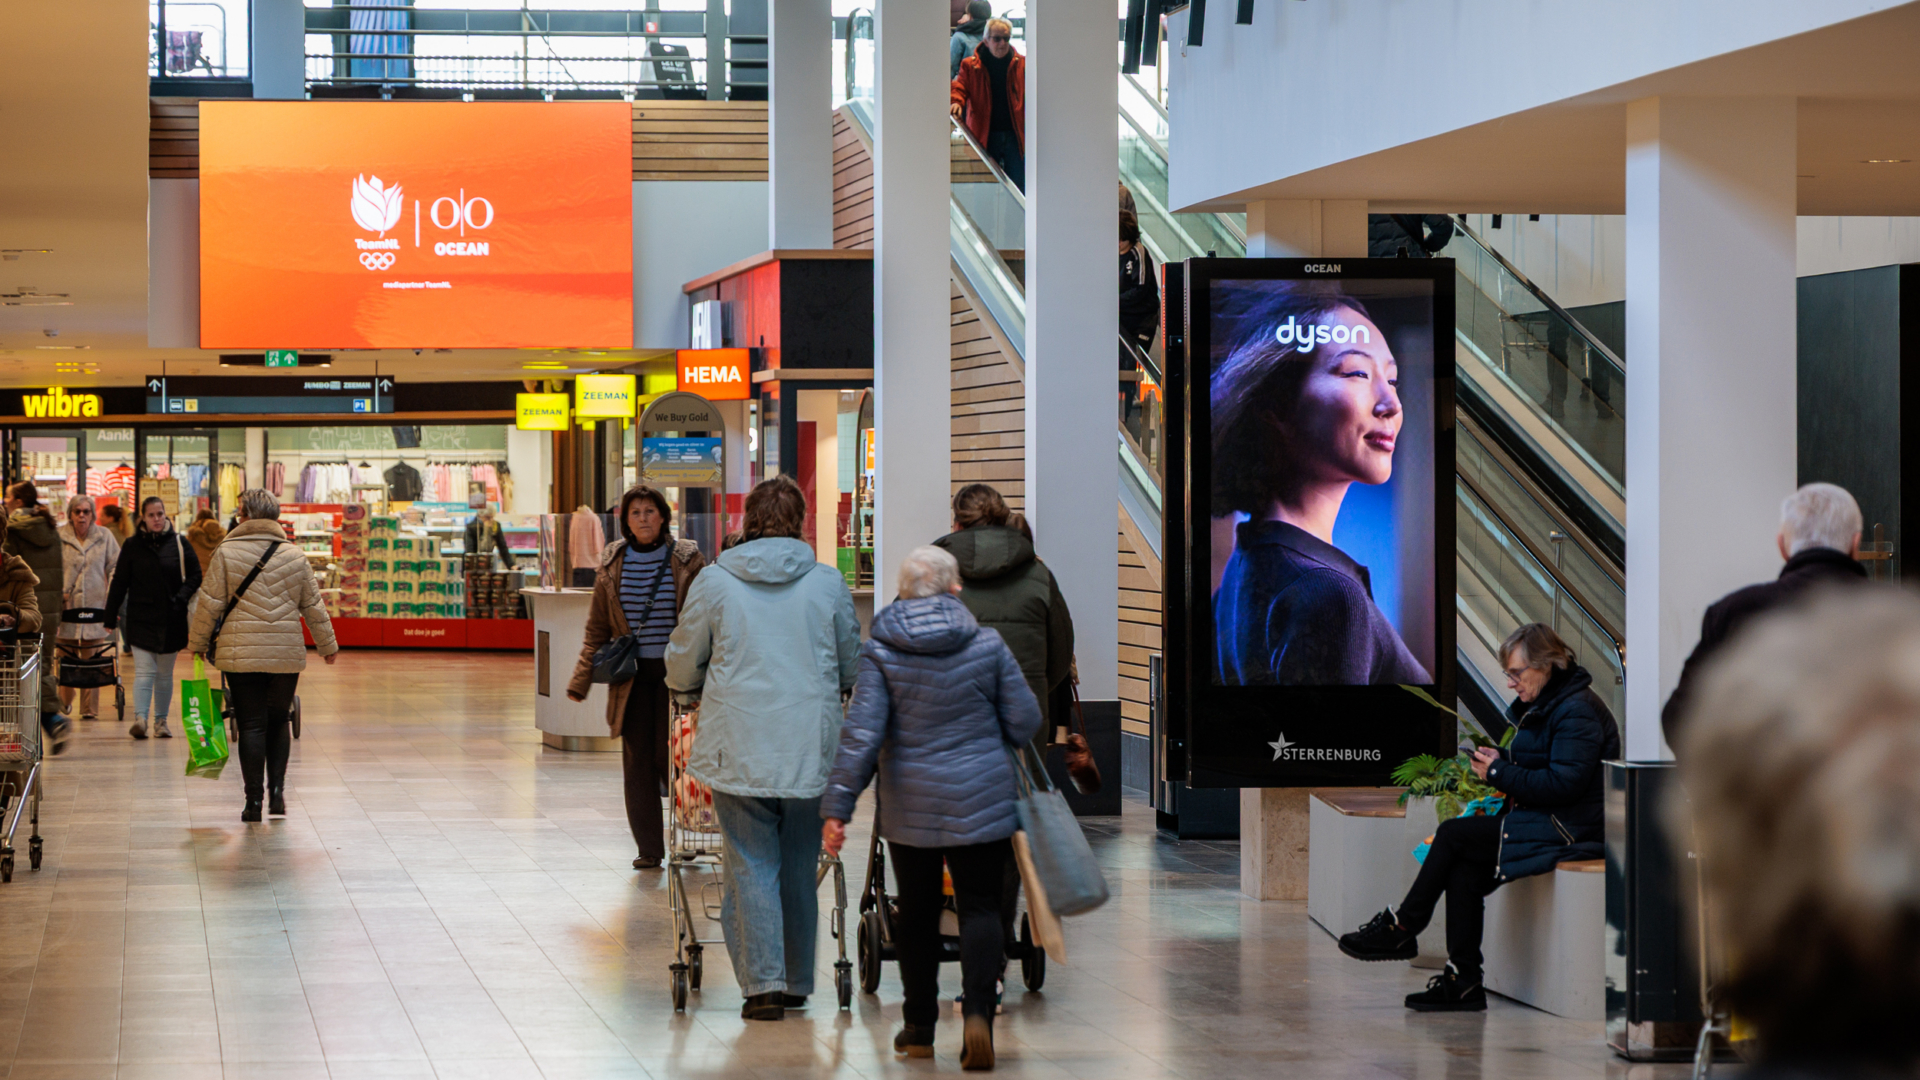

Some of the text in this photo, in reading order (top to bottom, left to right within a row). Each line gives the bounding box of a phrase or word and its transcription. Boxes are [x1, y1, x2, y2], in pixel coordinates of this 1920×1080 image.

[354, 238, 400, 250] TeamNL
[434, 242, 489, 256] OCEAN
[1304, 264, 1342, 273] OCEAN
[383, 281, 452, 289] mediapartner TeamNL
[1275, 316, 1370, 354] dyson
[684, 366, 742, 384] HEMA
[583, 391, 629, 401] ZEEMAN
[22, 387, 100, 418] wibra
[523, 408, 563, 416] ZEEMAN
[655, 413, 709, 424] We Buy Gold
[404, 628, 445, 637] Dat doe je goed
[189, 696, 207, 736] plus
[1283, 748, 1381, 761] STERRENBURG
